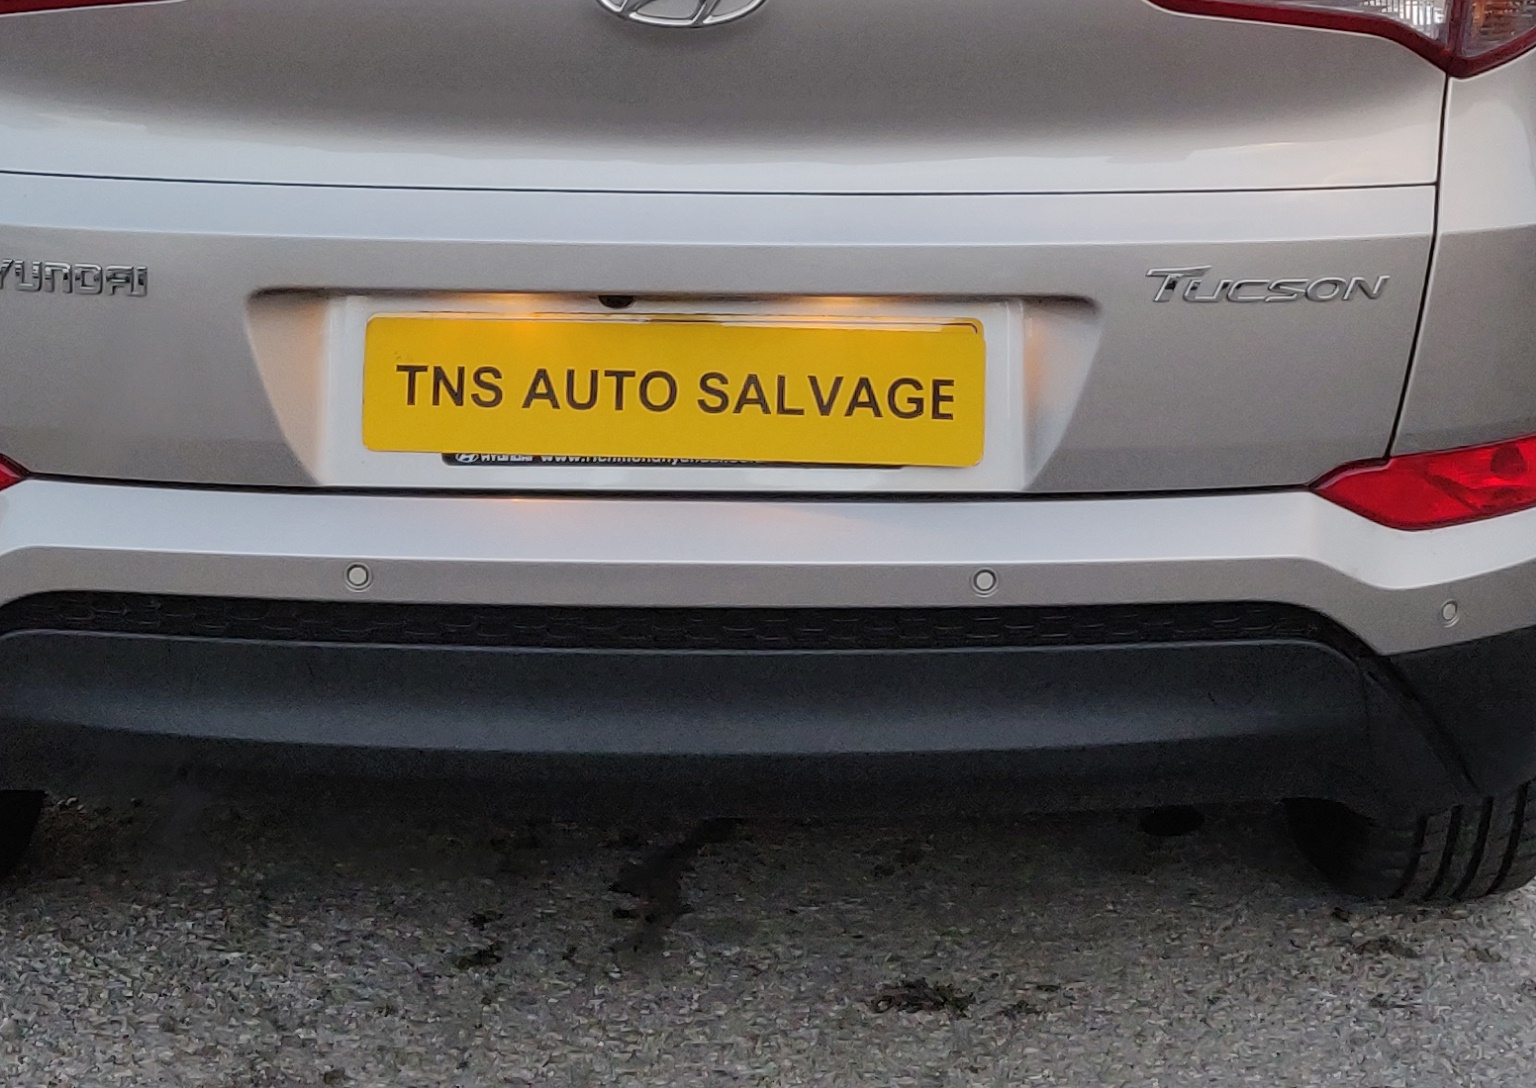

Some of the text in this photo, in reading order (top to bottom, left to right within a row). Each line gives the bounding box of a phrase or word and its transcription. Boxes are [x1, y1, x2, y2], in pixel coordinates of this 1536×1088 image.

[396, 364, 955, 421] TNS AUTO SALVAGE
